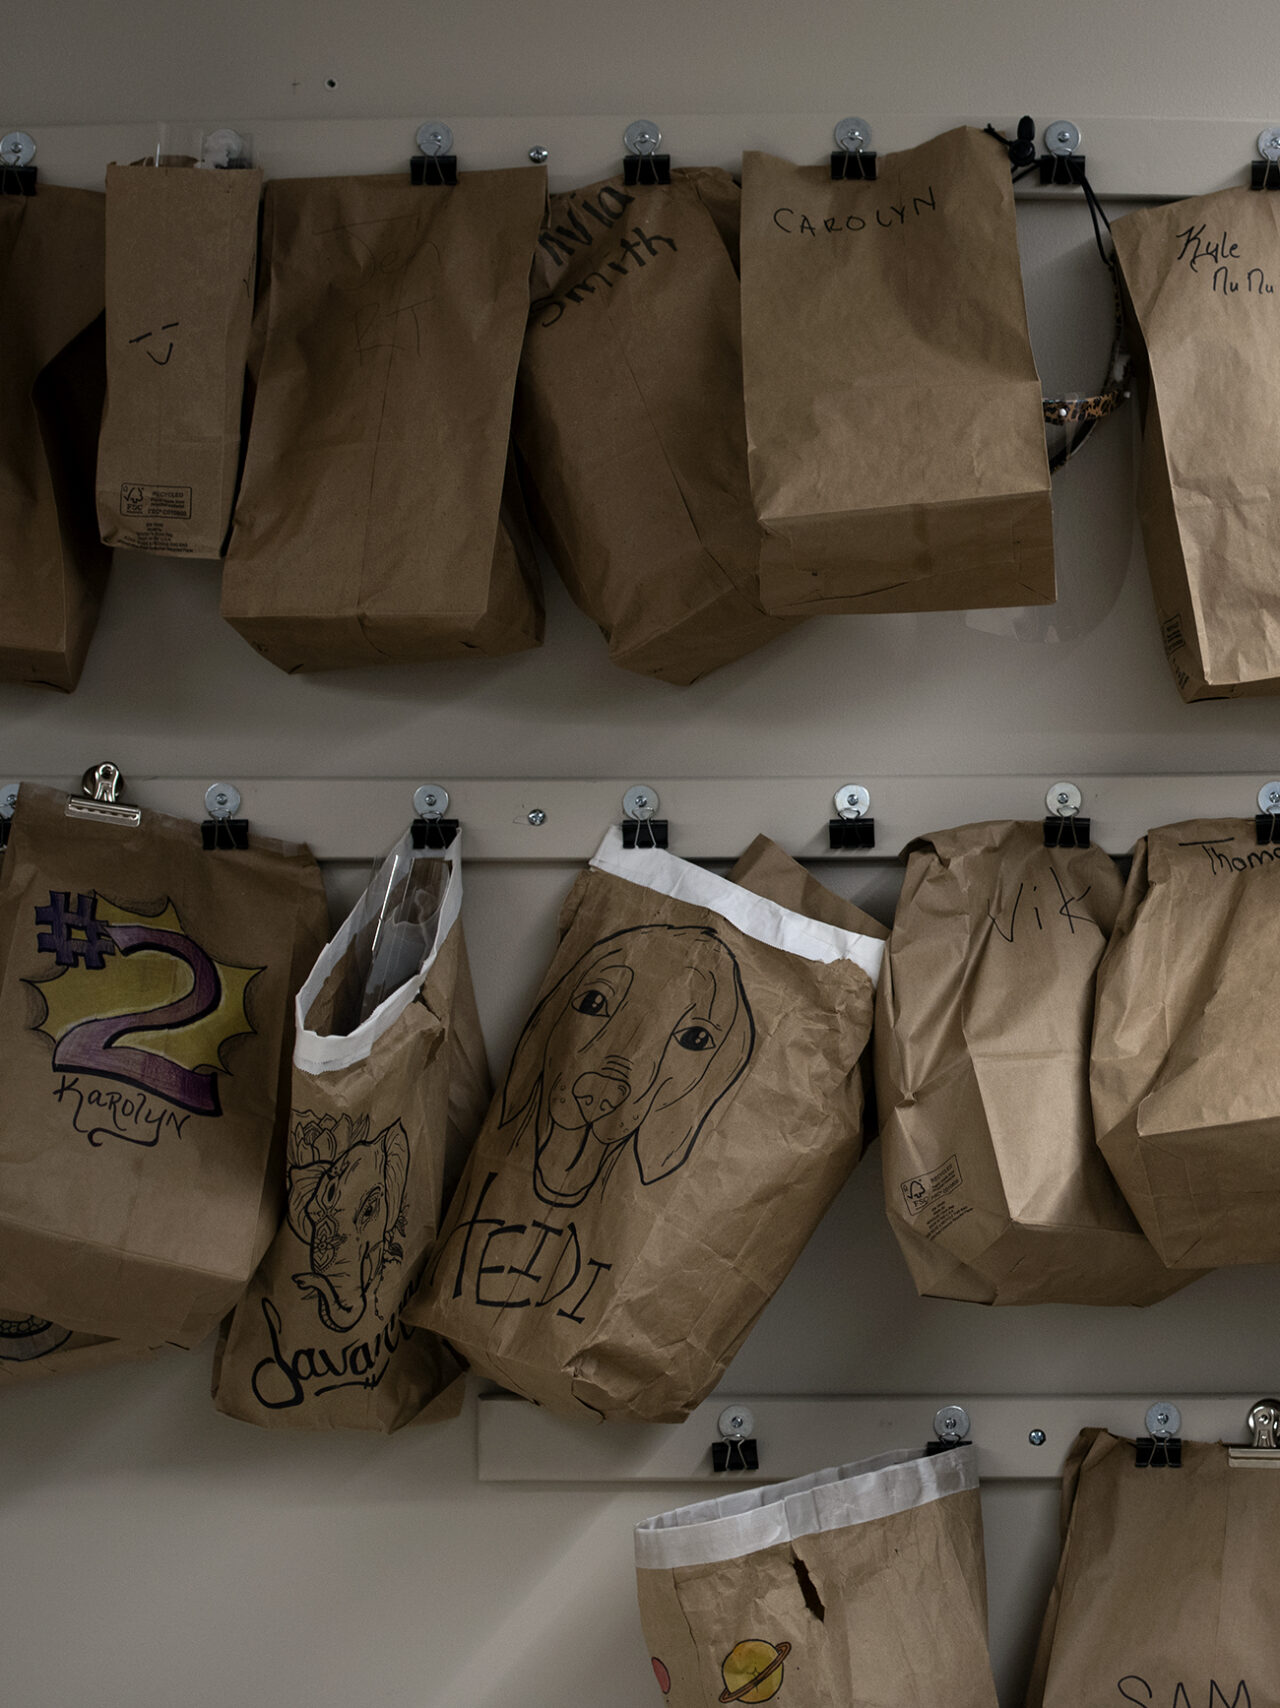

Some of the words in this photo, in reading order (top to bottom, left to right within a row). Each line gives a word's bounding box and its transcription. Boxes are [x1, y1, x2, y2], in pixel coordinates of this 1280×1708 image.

[774, 186, 936, 237] CAROLYN
[1175, 223, 1241, 273] Kyle
[987, 866, 1098, 943] Vik
